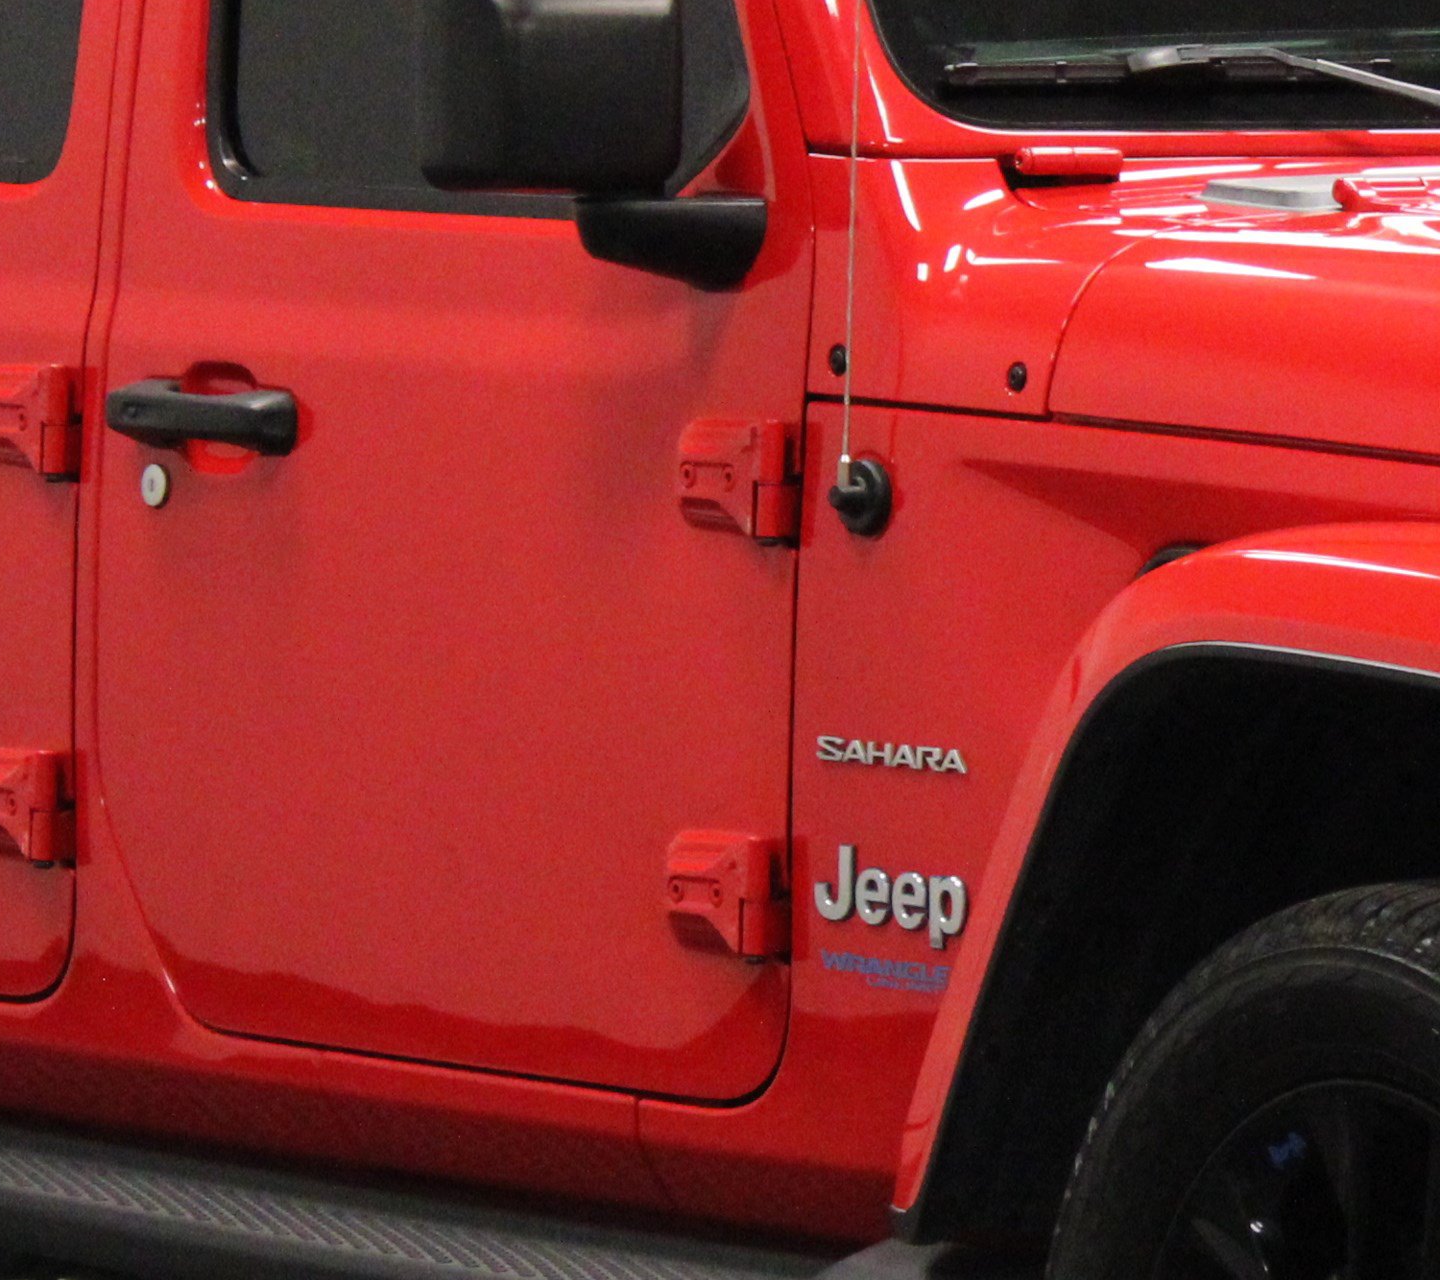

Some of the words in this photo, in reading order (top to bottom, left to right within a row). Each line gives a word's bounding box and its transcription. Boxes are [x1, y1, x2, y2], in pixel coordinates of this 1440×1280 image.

[816, 735, 967, 773] SAHARA
[814, 843, 966, 949] Jeep
[821, 949, 952, 981] WRANGLE
